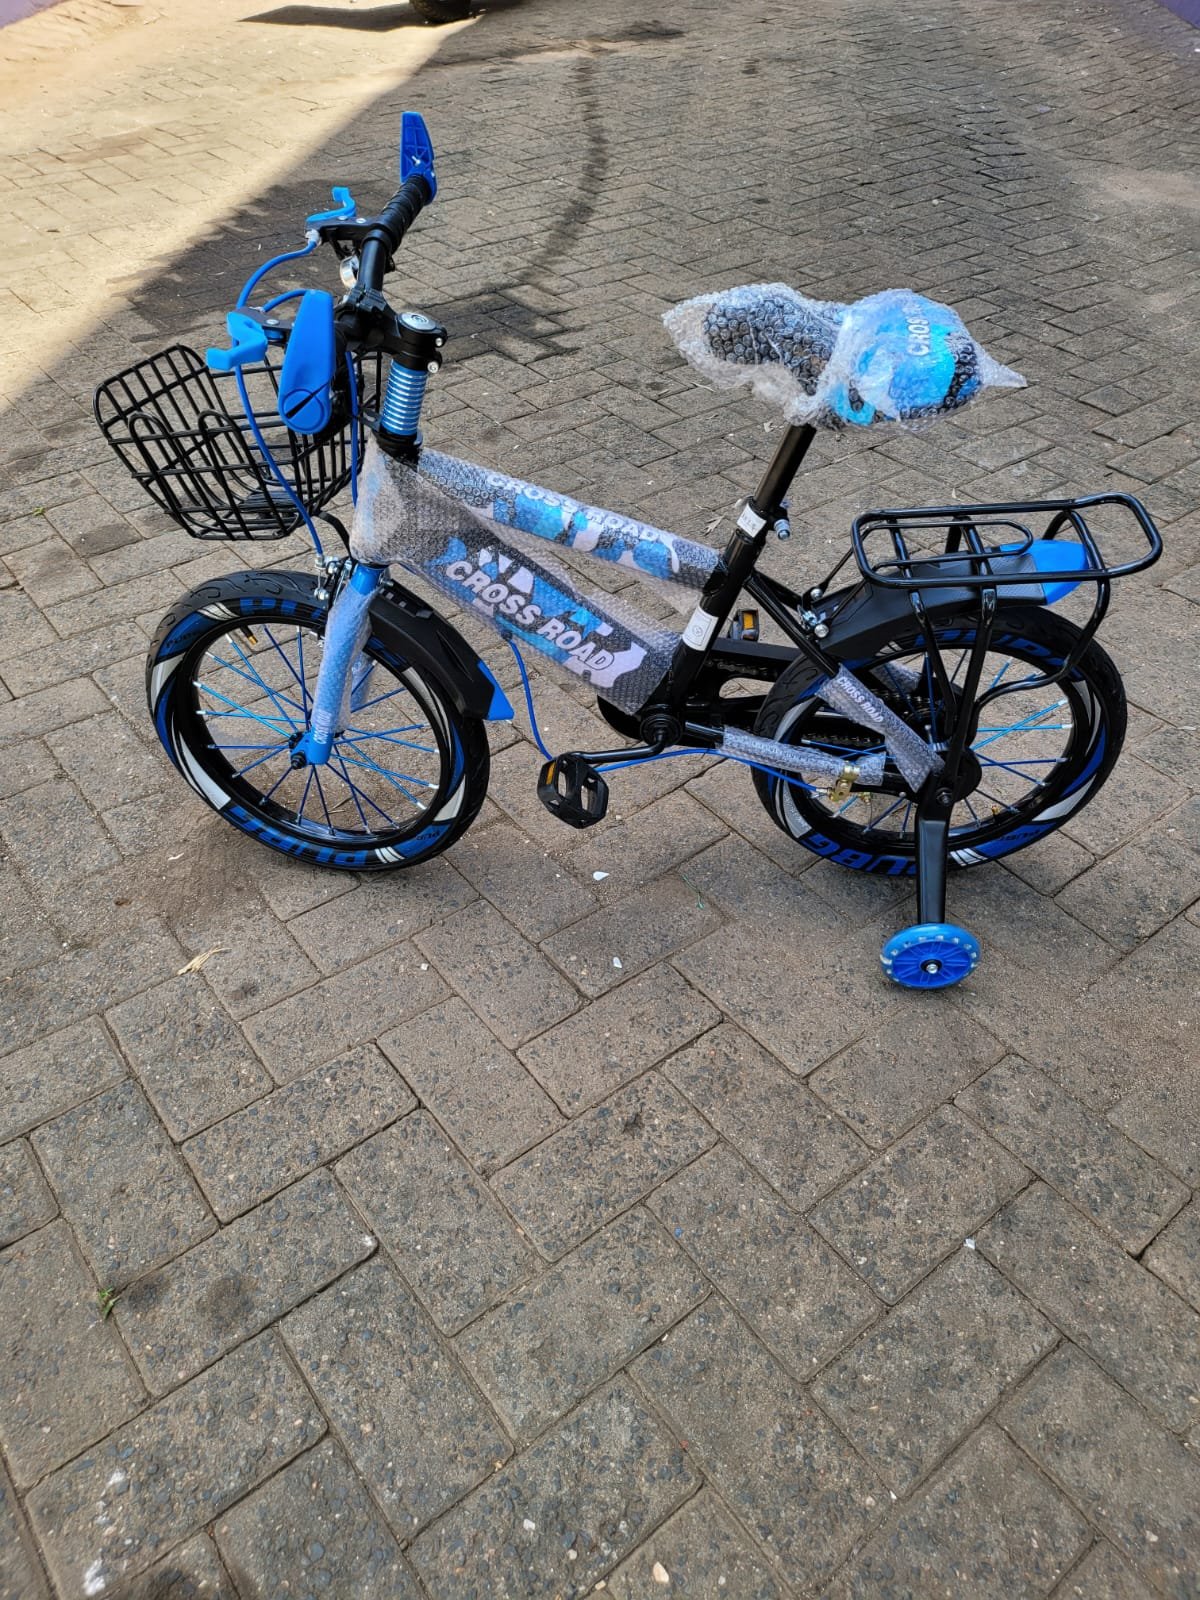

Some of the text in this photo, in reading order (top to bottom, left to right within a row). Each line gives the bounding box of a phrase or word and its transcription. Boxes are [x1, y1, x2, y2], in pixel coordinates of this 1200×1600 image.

[486, 473, 661, 542] CROSS ROAD
[445, 560, 615, 671] CROSS ROAD
[836, 675, 884, 724] CROSS ROAD
[800, 832, 919, 877] UBG
